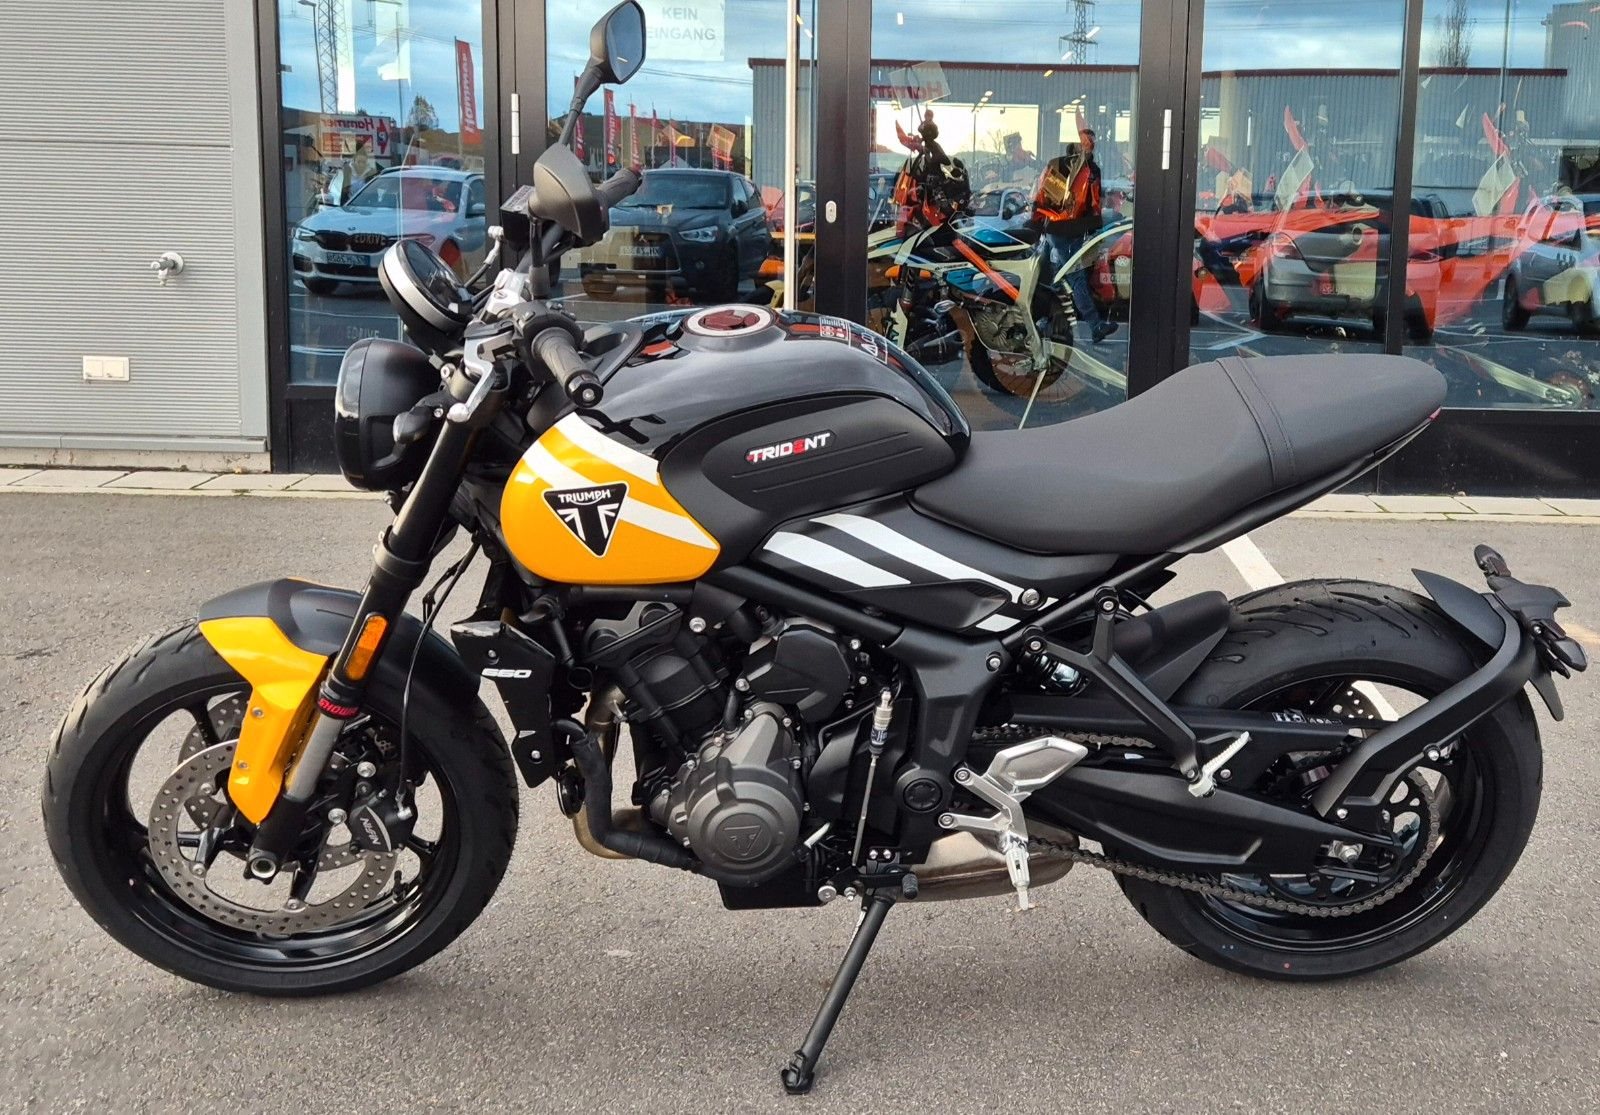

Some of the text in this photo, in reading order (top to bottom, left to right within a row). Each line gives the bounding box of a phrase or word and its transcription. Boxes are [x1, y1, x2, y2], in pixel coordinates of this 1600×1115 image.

[661, 7, 698, 20] KEIN
[646, 27, 716, 40] EINGANG
[462, 52, 476, 133] Hammer
[747, 432, 831, 463] TRIDENT
[557, 489, 612, 505] TRIUMPH
[481, 668, 533, 679] 660
